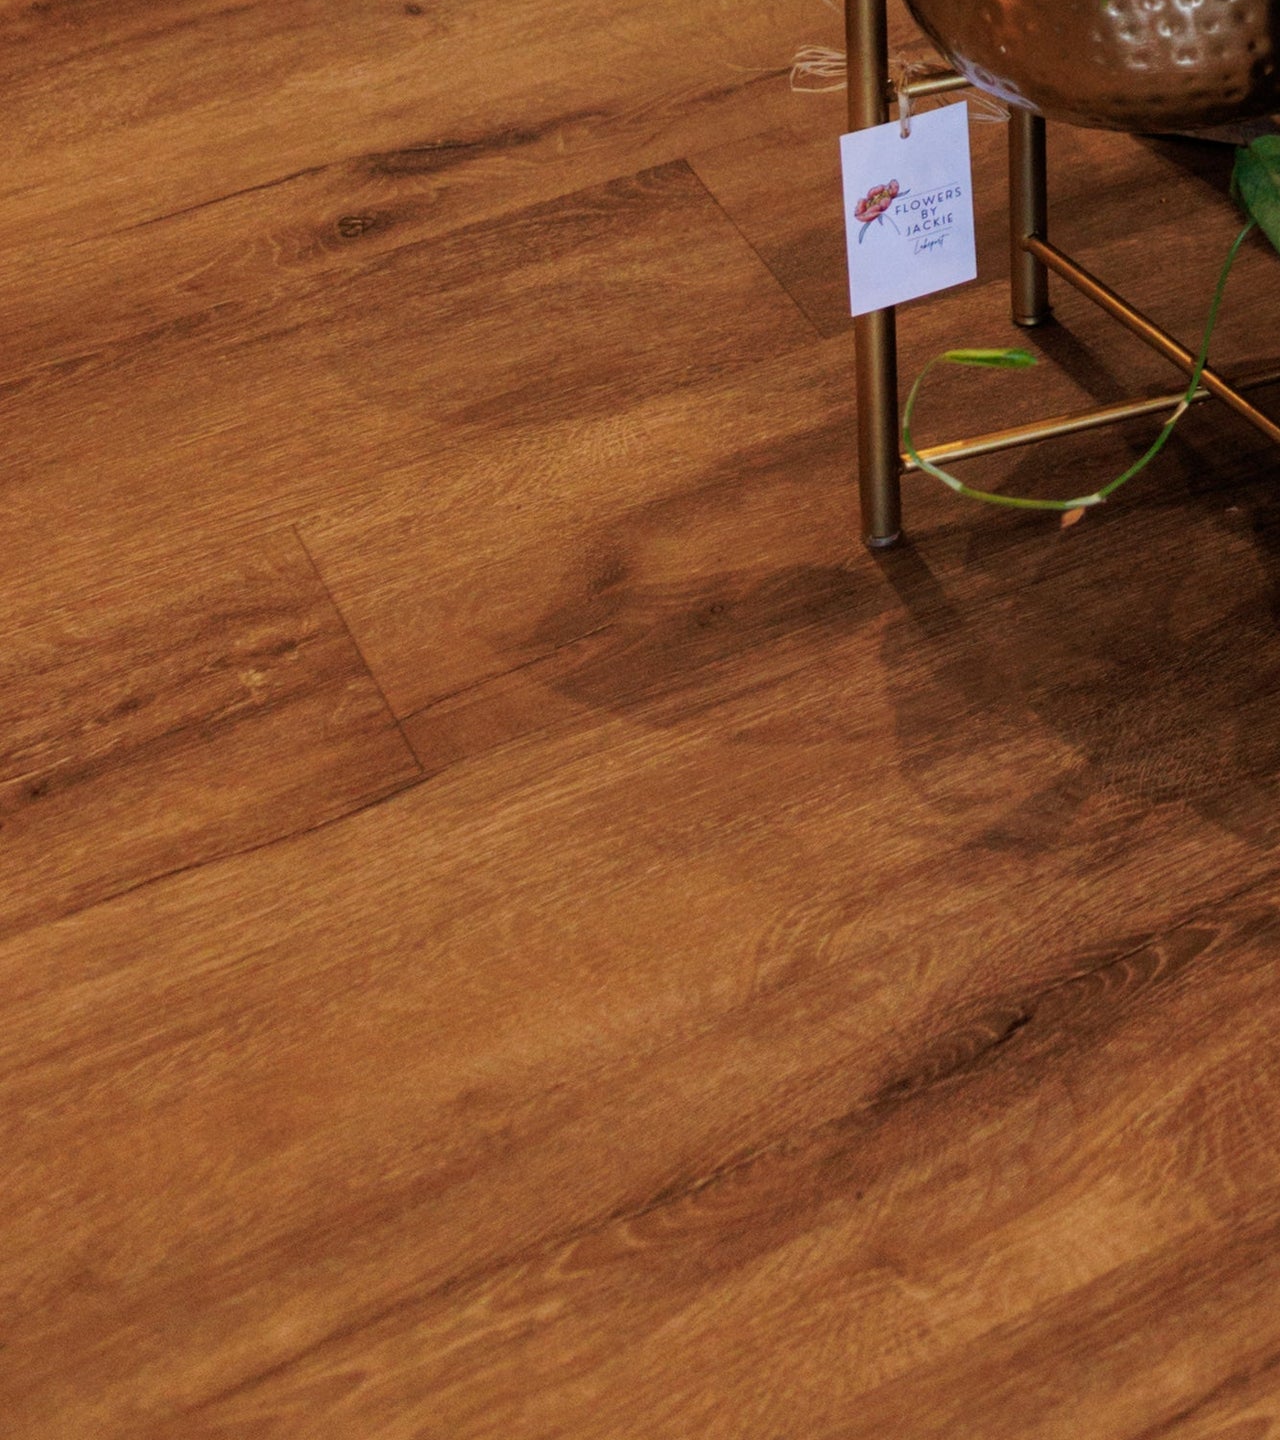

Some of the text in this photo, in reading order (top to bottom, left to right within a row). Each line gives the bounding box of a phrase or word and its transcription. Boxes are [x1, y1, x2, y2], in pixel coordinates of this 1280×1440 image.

[895, 186, 962, 216] FLOWERS
[921, 206, 937, 220] BY
[906, 212, 953, 237] JACKIE
